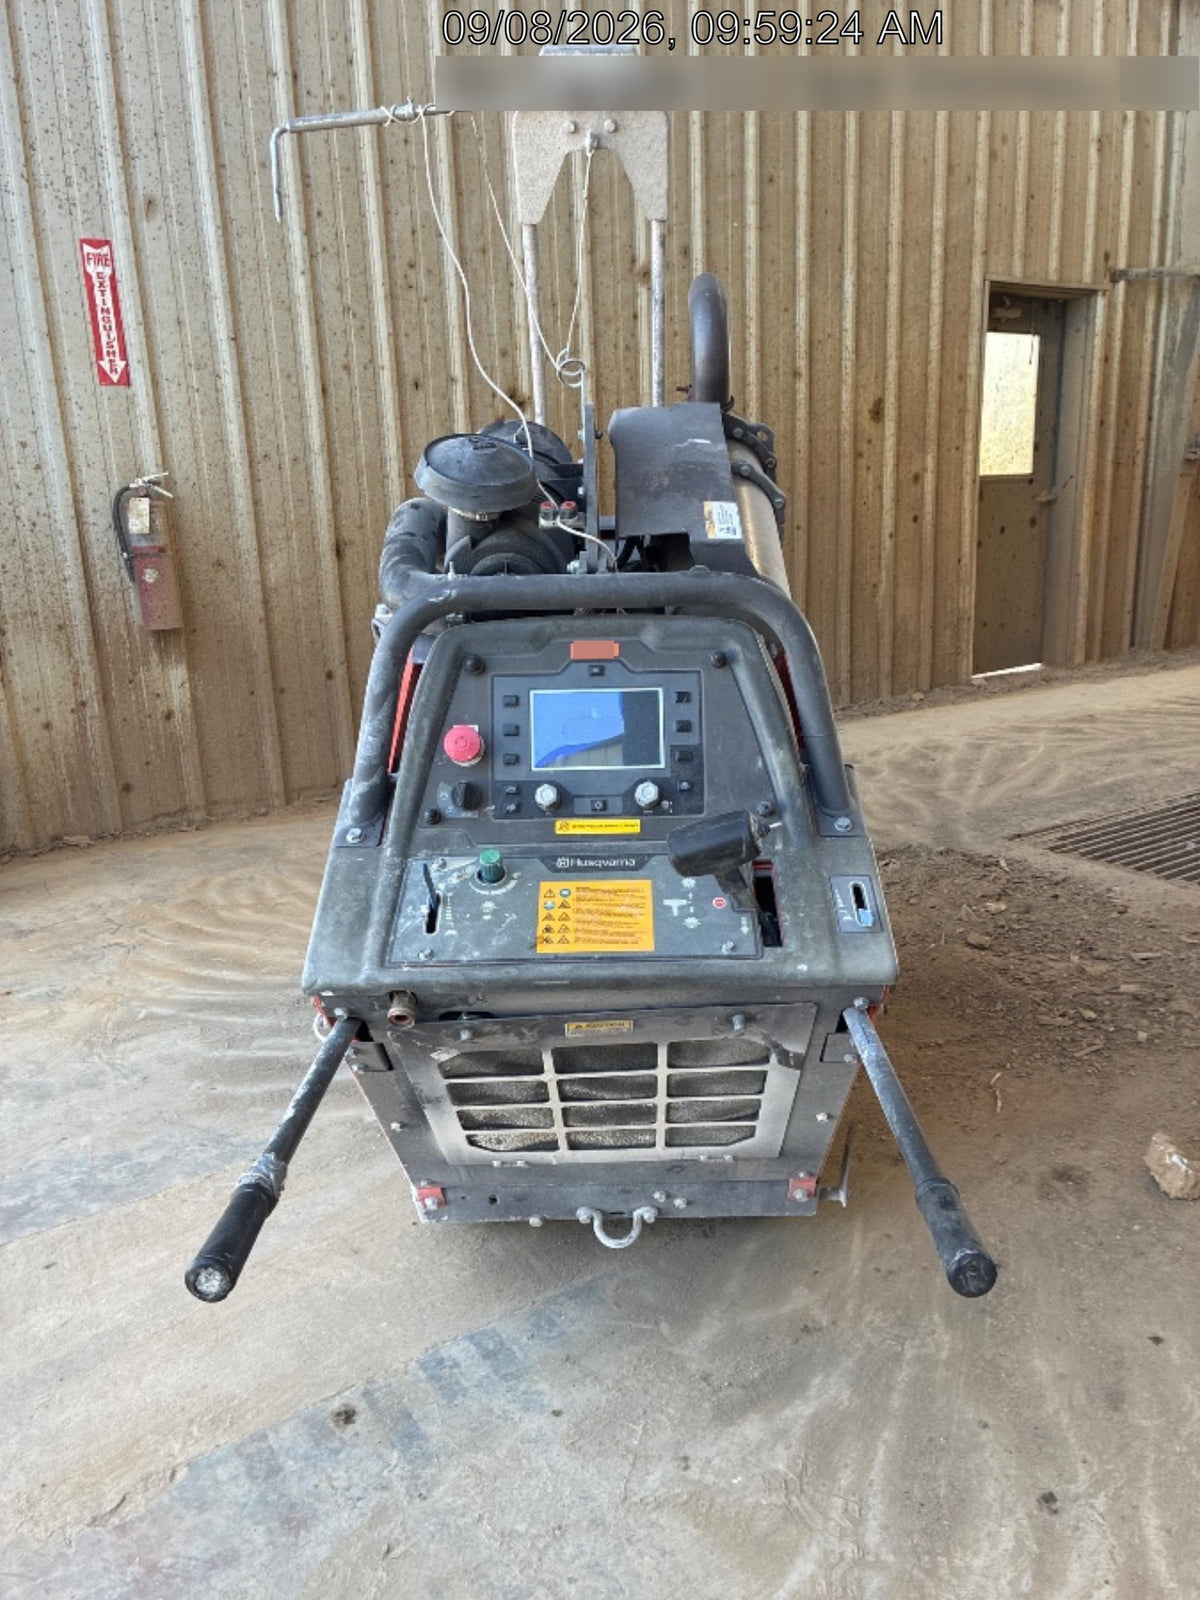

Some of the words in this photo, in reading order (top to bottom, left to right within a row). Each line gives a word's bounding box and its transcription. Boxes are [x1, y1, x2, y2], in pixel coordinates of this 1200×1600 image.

[86, 251, 111, 268] FIRE
[96, 271, 119, 375] EXTINGUISHER
[570, 857, 636, 867] Husqvarna
